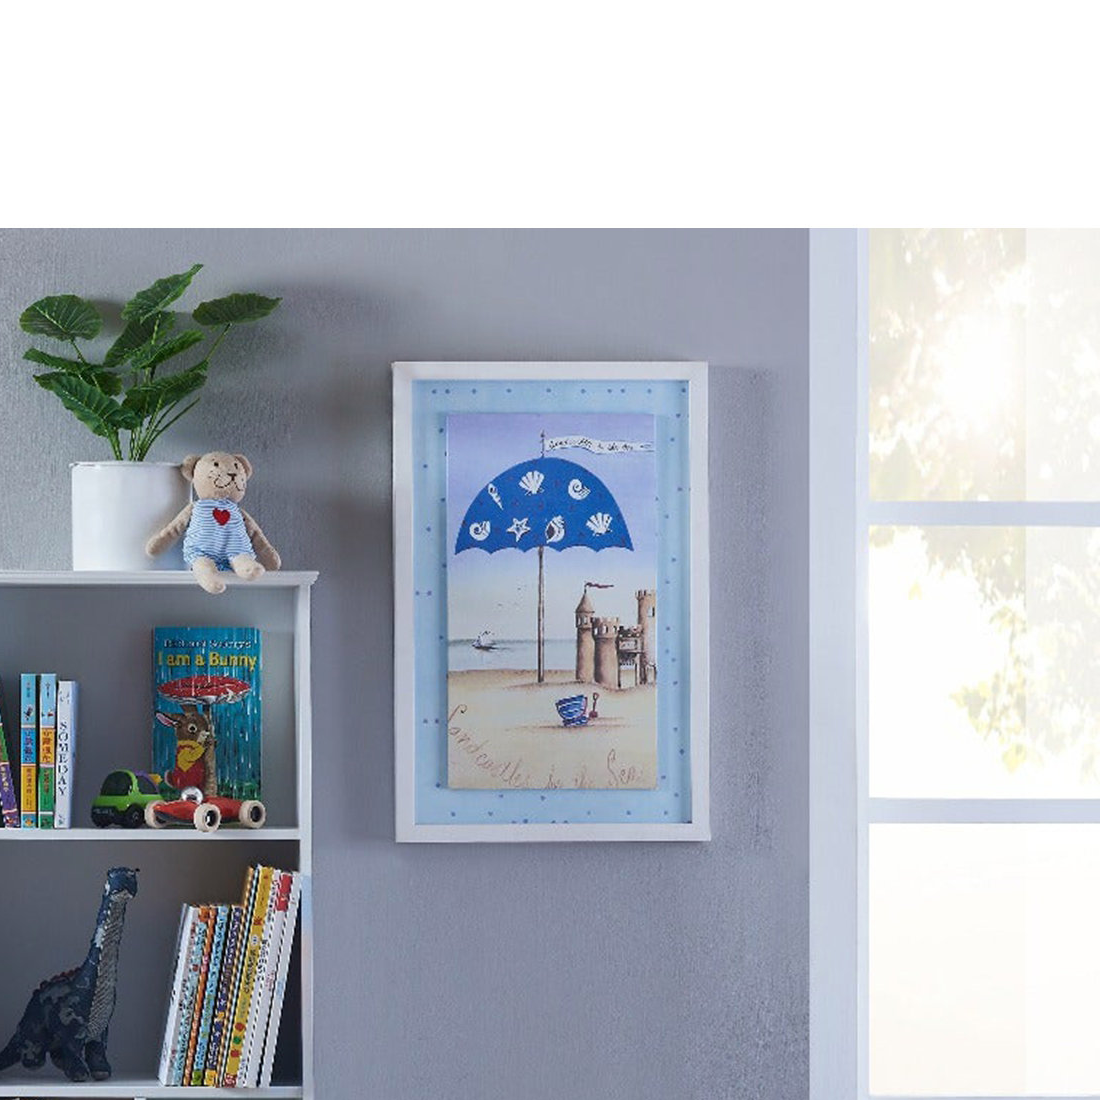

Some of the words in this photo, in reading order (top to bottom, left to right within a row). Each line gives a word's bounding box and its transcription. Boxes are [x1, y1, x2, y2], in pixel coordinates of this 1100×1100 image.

[158, 651, 163, 665] I
[167, 654, 191, 666] am
[195, 654, 205, 666] a
[209, 651, 257, 671] Bunny
[57, 721, 69, 796] SOMEDAY
